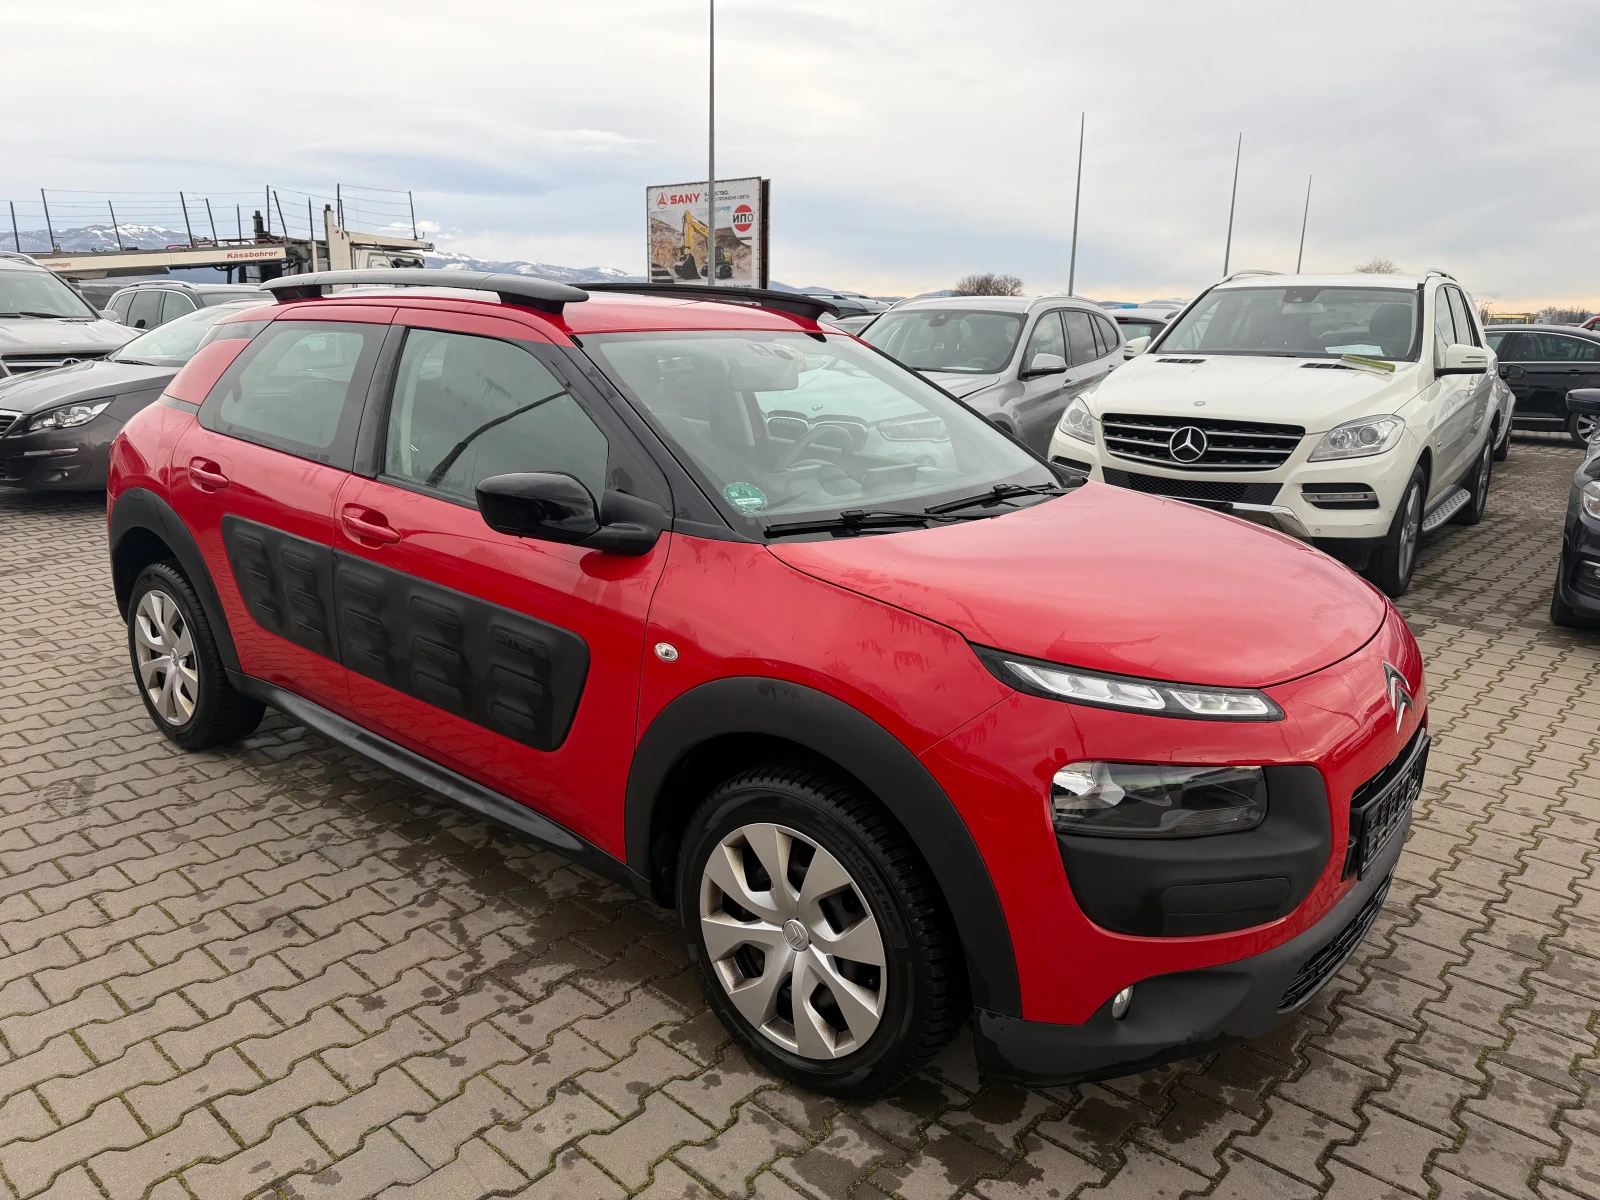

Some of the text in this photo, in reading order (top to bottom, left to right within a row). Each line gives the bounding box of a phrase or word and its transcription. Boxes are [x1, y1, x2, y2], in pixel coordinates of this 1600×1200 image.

[670, 193, 700, 205] SANY
[732, 213, 754, 223] ИПО
[227, 251, 278, 259] Kässbohrer
